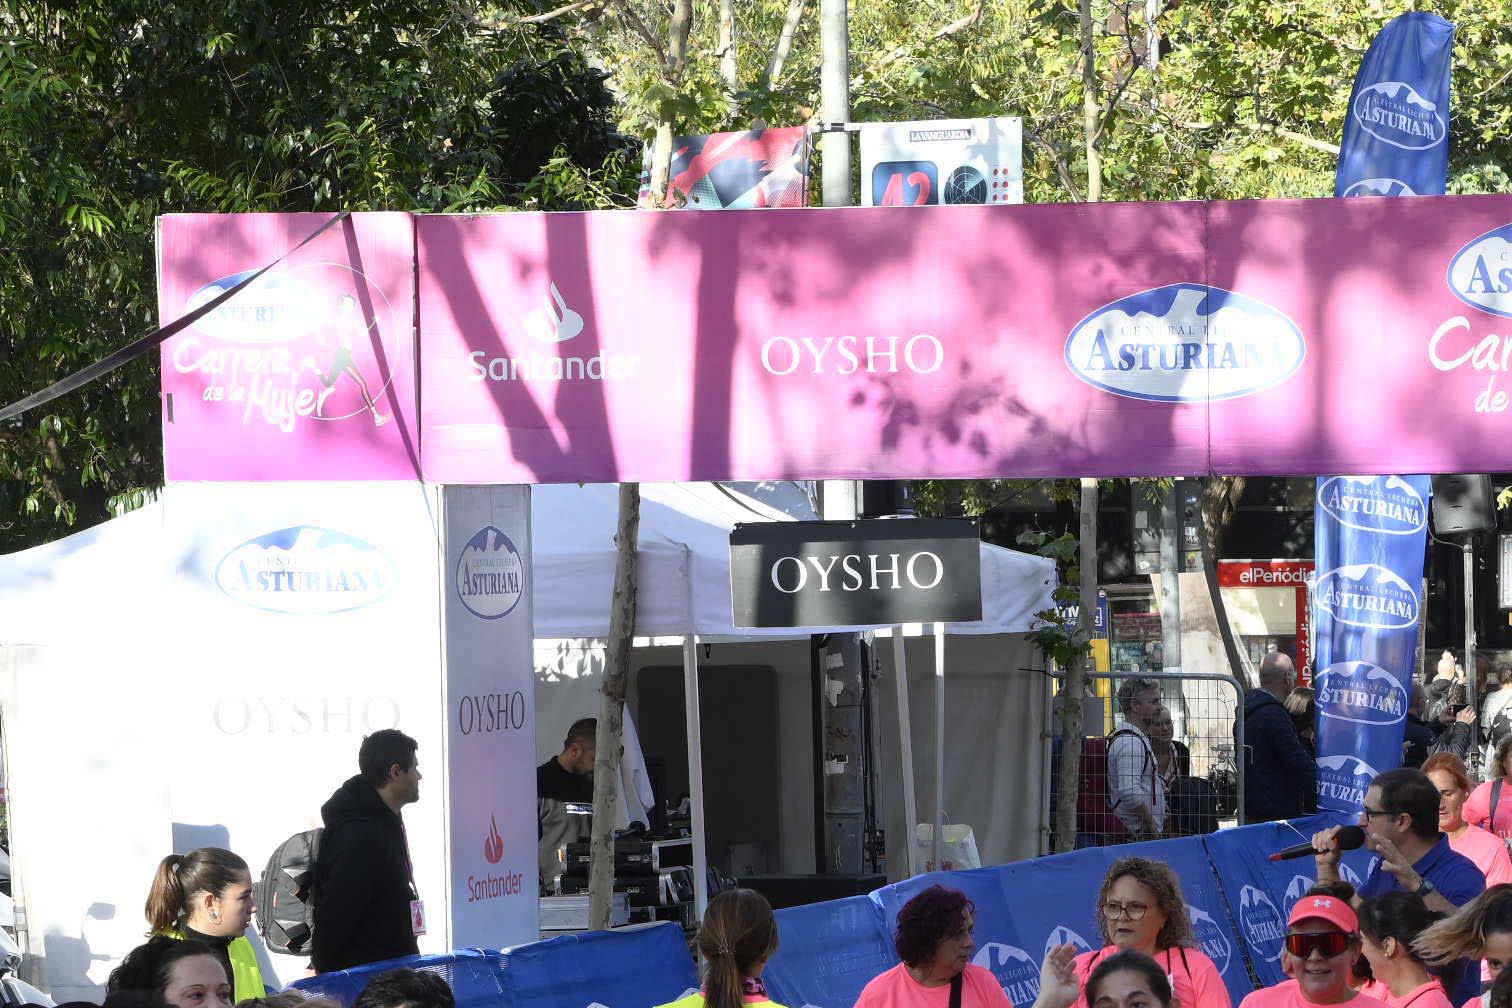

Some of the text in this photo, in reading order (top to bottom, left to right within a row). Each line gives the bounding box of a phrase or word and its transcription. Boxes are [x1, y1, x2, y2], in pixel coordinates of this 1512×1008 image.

[1360, 96, 1436, 141] ASTURIANA
[173, 338, 294, 374] Carrera
[467, 350, 642, 382] Santander
[761, 334, 944, 377] OYSHO
[203, 382, 225, 401] de
[242, 370, 336, 433] Mujer
[1475, 374, 1509, 413] de
[1328, 486, 1420, 526] ASTURIANA
[233, 559, 387, 595] ASTURIANA
[462, 559, 520, 596] ASTURIANA
[771, 551, 944, 594] OYSHO
[1323, 583, 1414, 621] ASTURIANA
[213, 695, 402, 736] OYSHO
[459, 691, 526, 736] OYSHO
[1318, 678, 1402, 717] ASTURIANA
[468, 869, 523, 904] Santander
